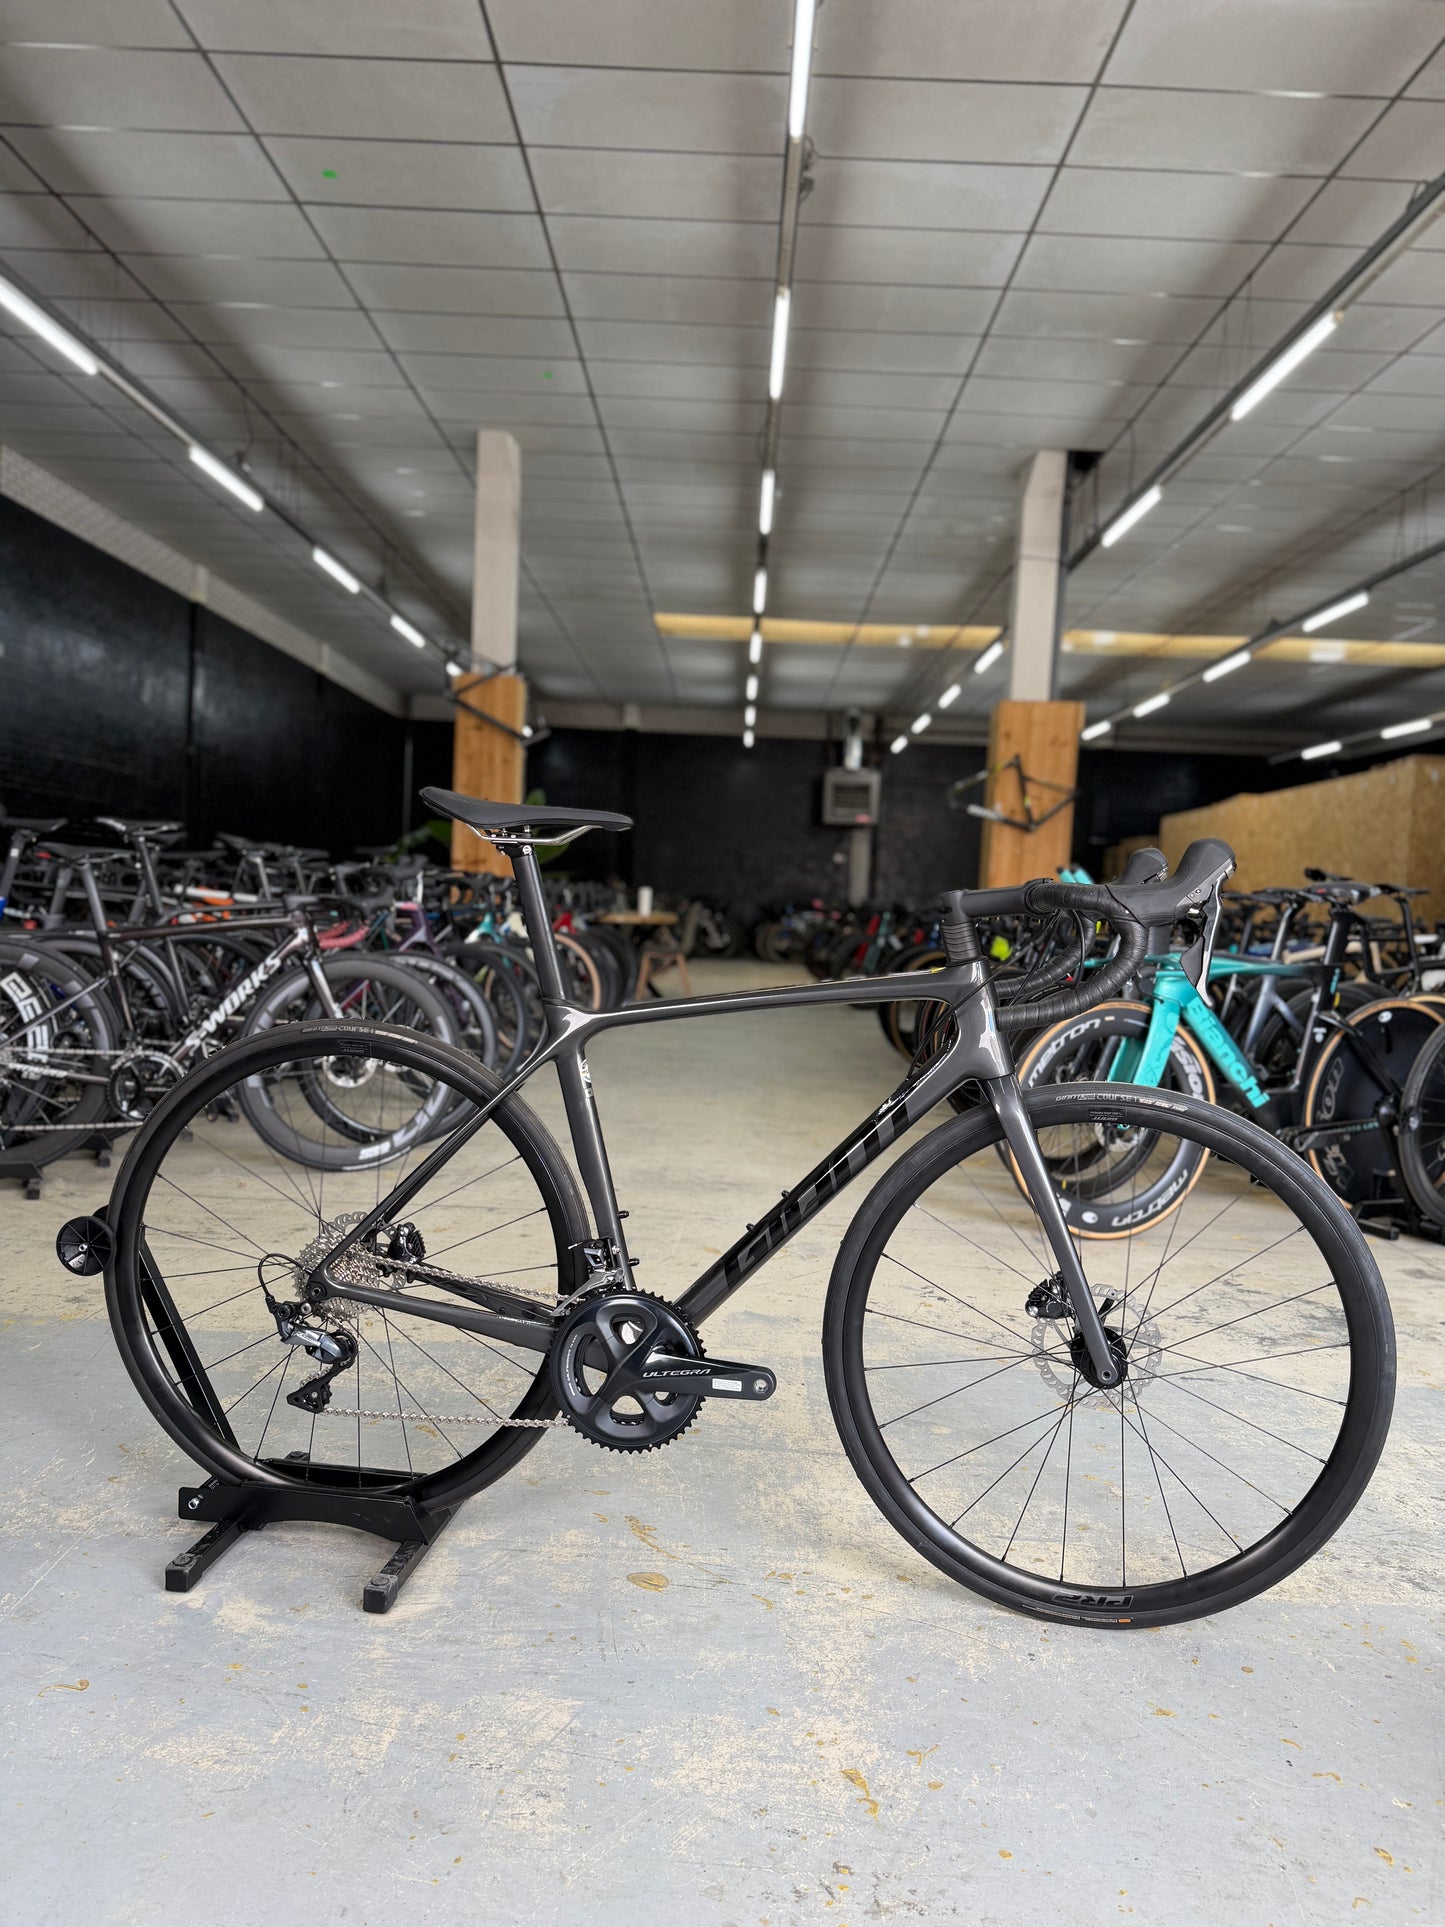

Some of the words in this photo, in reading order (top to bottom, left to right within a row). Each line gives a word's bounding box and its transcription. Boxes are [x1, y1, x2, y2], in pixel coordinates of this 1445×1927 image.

[184, 951, 281, 1057] S-WORKS
[1028, 1018, 1101, 1088] metron
[1186, 998, 1271, 1108] Bianchi
[1096, 1093, 1133, 1103] COURSE
[642, 1368, 712, 1378] ULTEGRA
